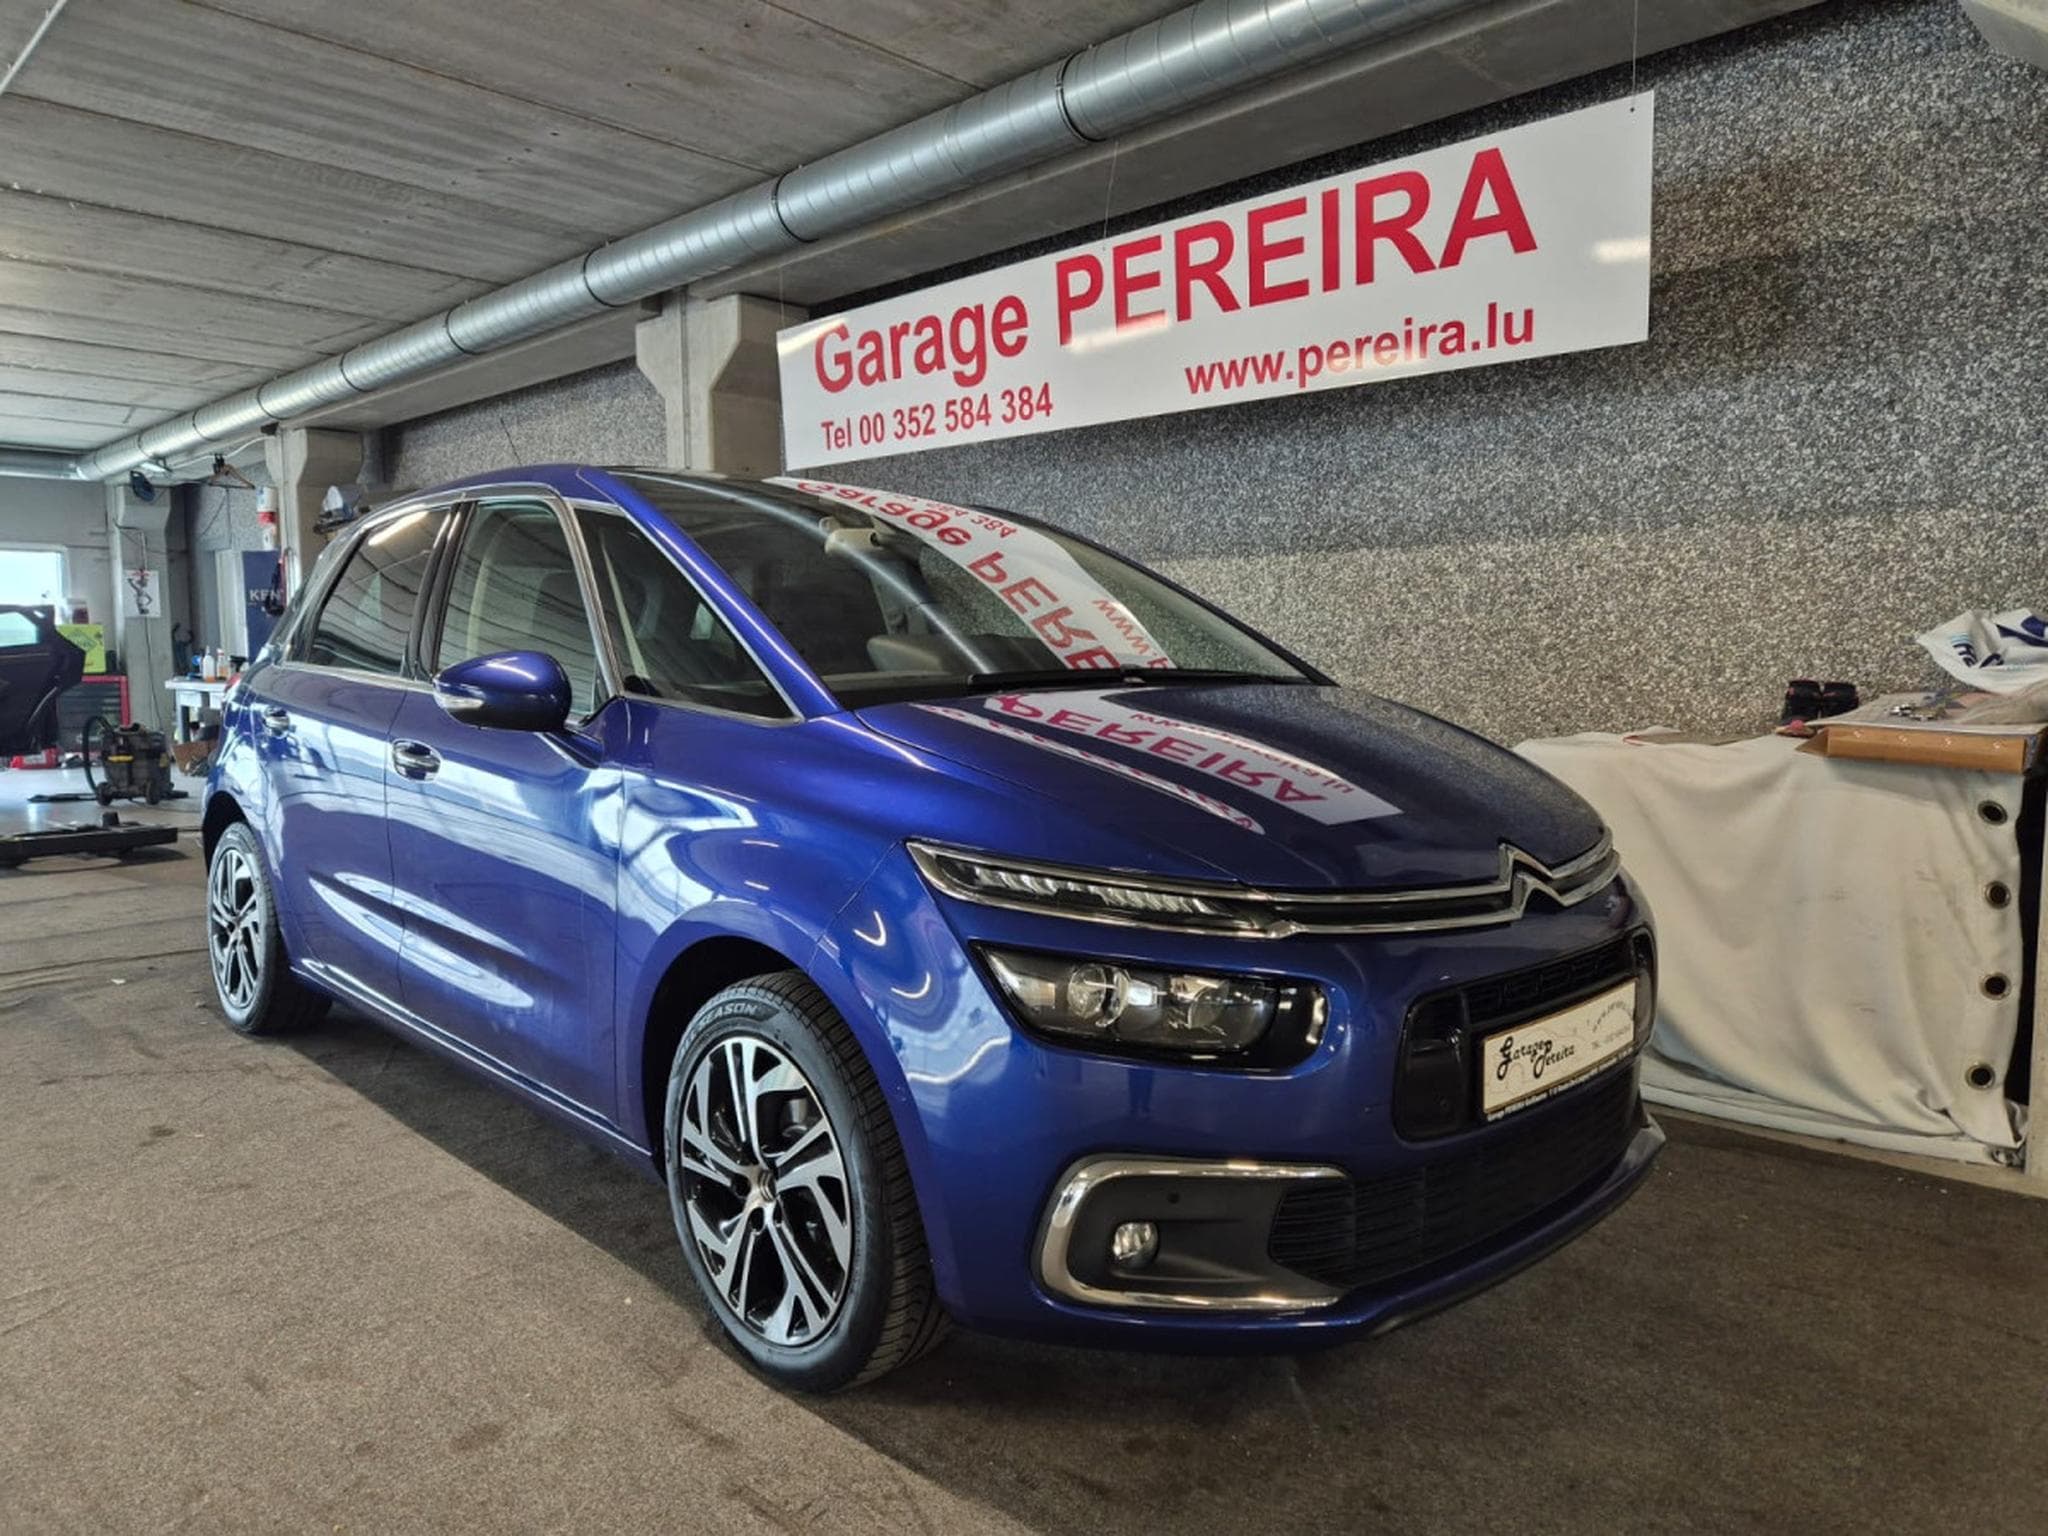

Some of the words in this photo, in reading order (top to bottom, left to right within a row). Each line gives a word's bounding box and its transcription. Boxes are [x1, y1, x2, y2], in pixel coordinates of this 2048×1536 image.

[814, 294, 1030, 394] Garage
[1055, 146, 1539, 347] PEREIRA
[1184, 302, 1536, 396] www.pereira.lu
[821, 418, 853, 451] Tel
[857, 411, 886, 447] 00
[892, 401, 938, 441] 352
[944, 392, 993, 433] 584
[1000, 382, 1055, 426] 384
[250, 589, 285, 602] KEN
[697, 1002, 758, 1028] SEASON
